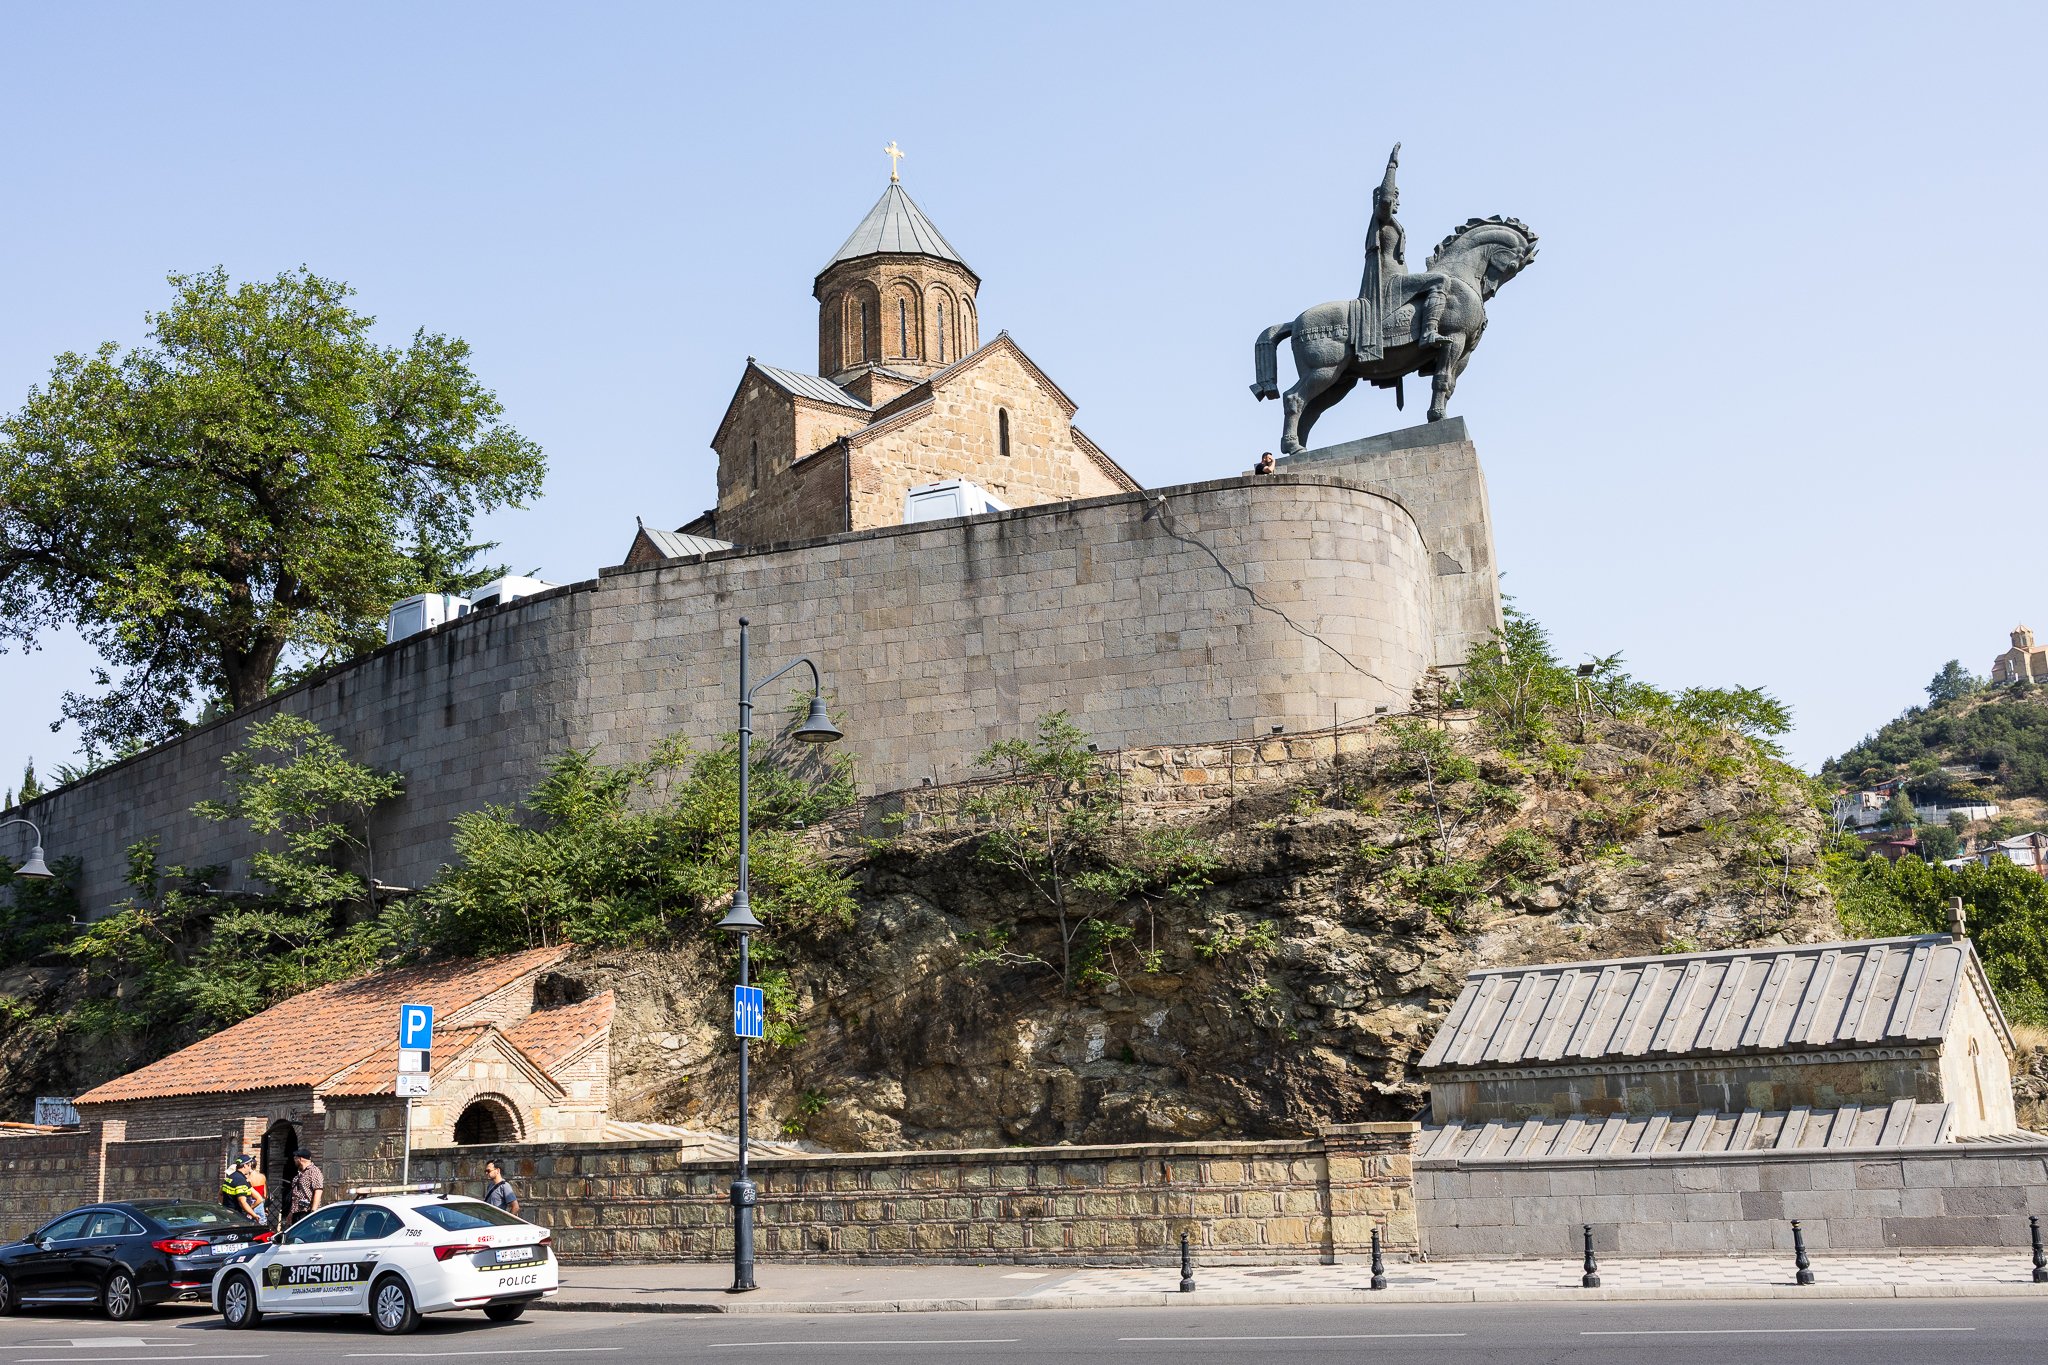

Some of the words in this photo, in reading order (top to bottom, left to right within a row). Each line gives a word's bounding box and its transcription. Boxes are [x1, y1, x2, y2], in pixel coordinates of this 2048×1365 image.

[407, 1009, 427, 1045] P
[405, 1229, 422, 1237] 7505
[288, 1263, 359, 1283] პოლიცია
[498, 1274, 537, 1287] POLICE
